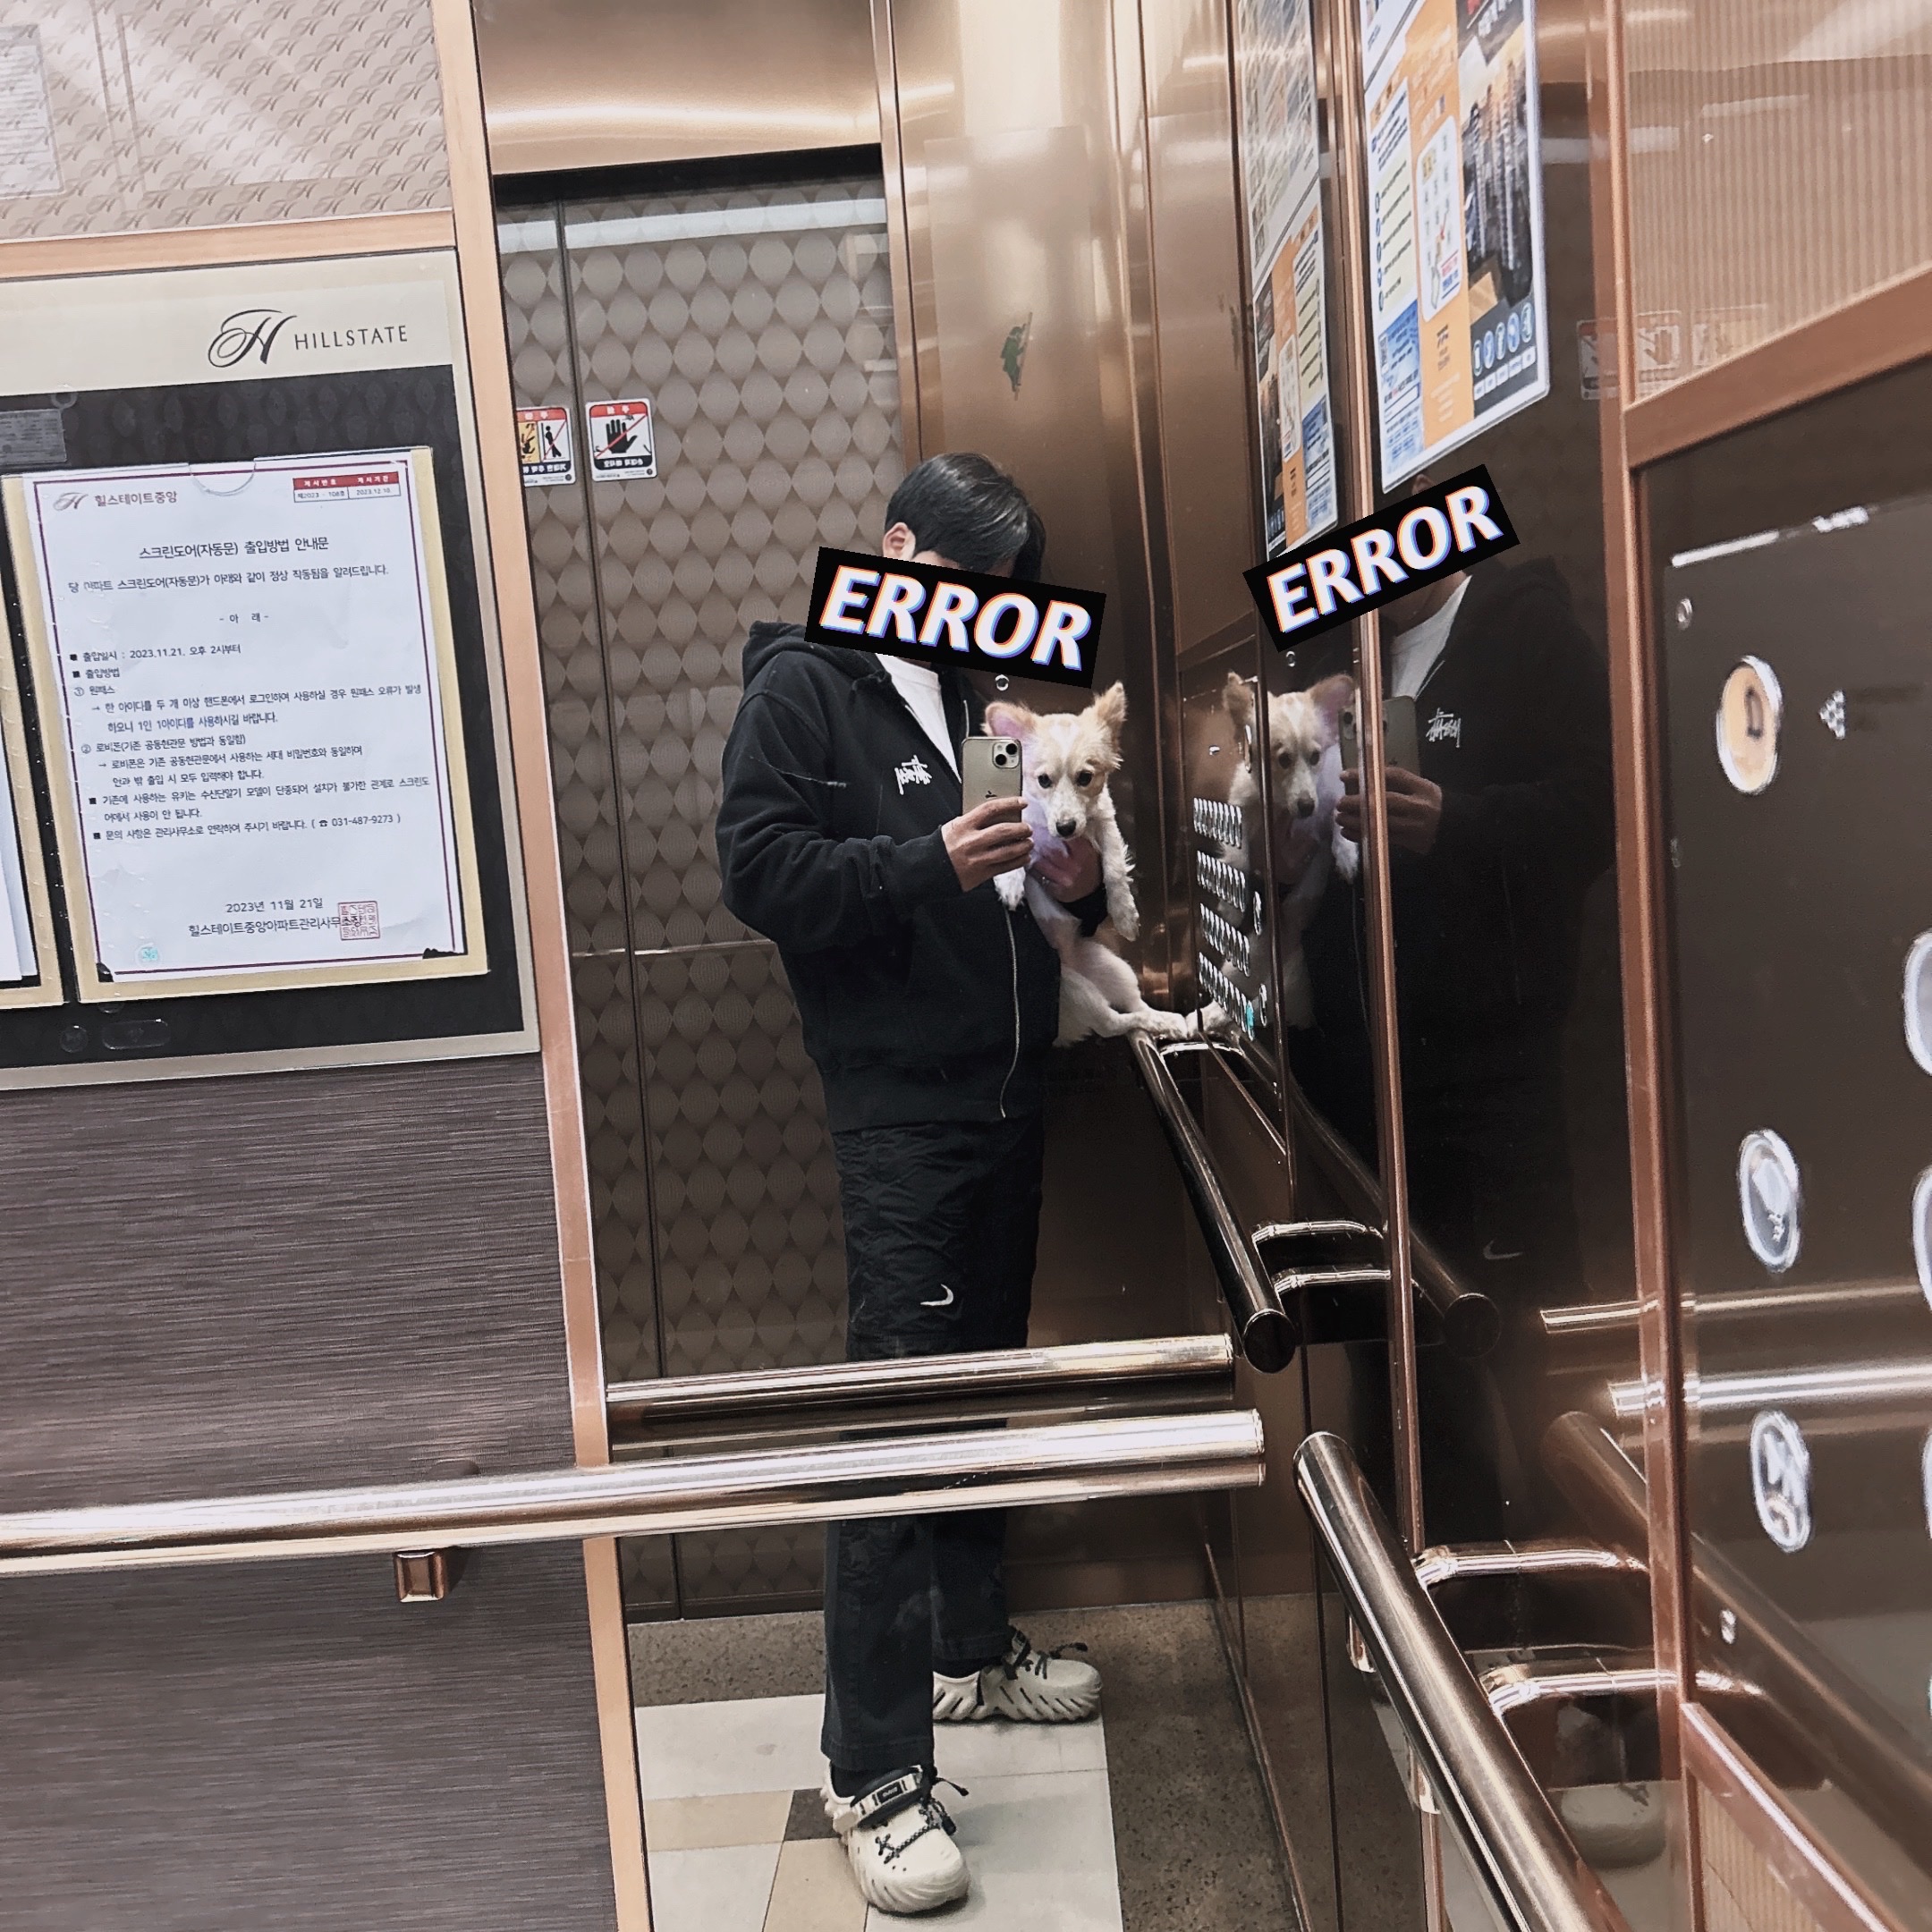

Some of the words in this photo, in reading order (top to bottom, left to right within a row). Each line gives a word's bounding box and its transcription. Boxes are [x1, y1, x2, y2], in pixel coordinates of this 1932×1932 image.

[294, 323, 408, 351] HILLSTATE
[95, 491, 177, 507] 힐스테이트중앙
[140, 542, 238, 559] 스크린도어(자동문)
[244, 538, 289, 555] 출입방법
[295, 537, 329, 550] 안내문
[68, 581, 79, 593] 당
[117, 575, 210, 589] 스크린도어(자동문)가
[214, 573, 242, 585] 아래와
[246, 572, 266, 583] 같이
[269, 570, 288, 582] 정상
[83, 650, 117, 662] 출입일시
[130, 648, 185, 659] 2023.11.21.
[189, 646, 207, 656] 오후
[210, 644, 242, 655] 2시부터
[85, 667, 120, 679] 출입방법
[105, 702, 114, 713] 한
[118, 699, 152, 713] 아이디를
[156, 699, 165, 709] 두
[169, 699, 179, 708] 개
[182, 698, 199, 708] 이상
[249, 692, 289, 704] 로그인하여
[293, 690, 326, 701] 사용하실
[329, 689, 346, 699] 경우
[107, 721, 133, 733] 하오니
[138, 720, 152, 732] 1인
[157, 717, 194, 730] 1아이디를
[199, 715, 239, 728] 사용하시길
[230, 751, 263, 763] 사용하는
[167, 774, 177, 784] 시
[181, 773, 198, 783] 모두
[200, 771, 233, 783] 입력해야
[133, 792, 166, 804] 사용하는
[313, 782, 337, 793] 설치가
[399, 776, 430, 787] 스크린도
[133, 809, 158, 821] 사용이
[162, 809, 171, 820] 안
[155, 826, 204, 837] 관리사무소로
[208, 823, 241, 835] 연락하여
[244, 821, 269, 832] 주시기
[272, 819, 308, 831] 바랍니다.
[331, 814, 394, 826] 031-487-9273
[225, 901, 265, 913] 2023년
[270, 899, 294, 911] 11월
[300, 897, 323, 910] 21일
